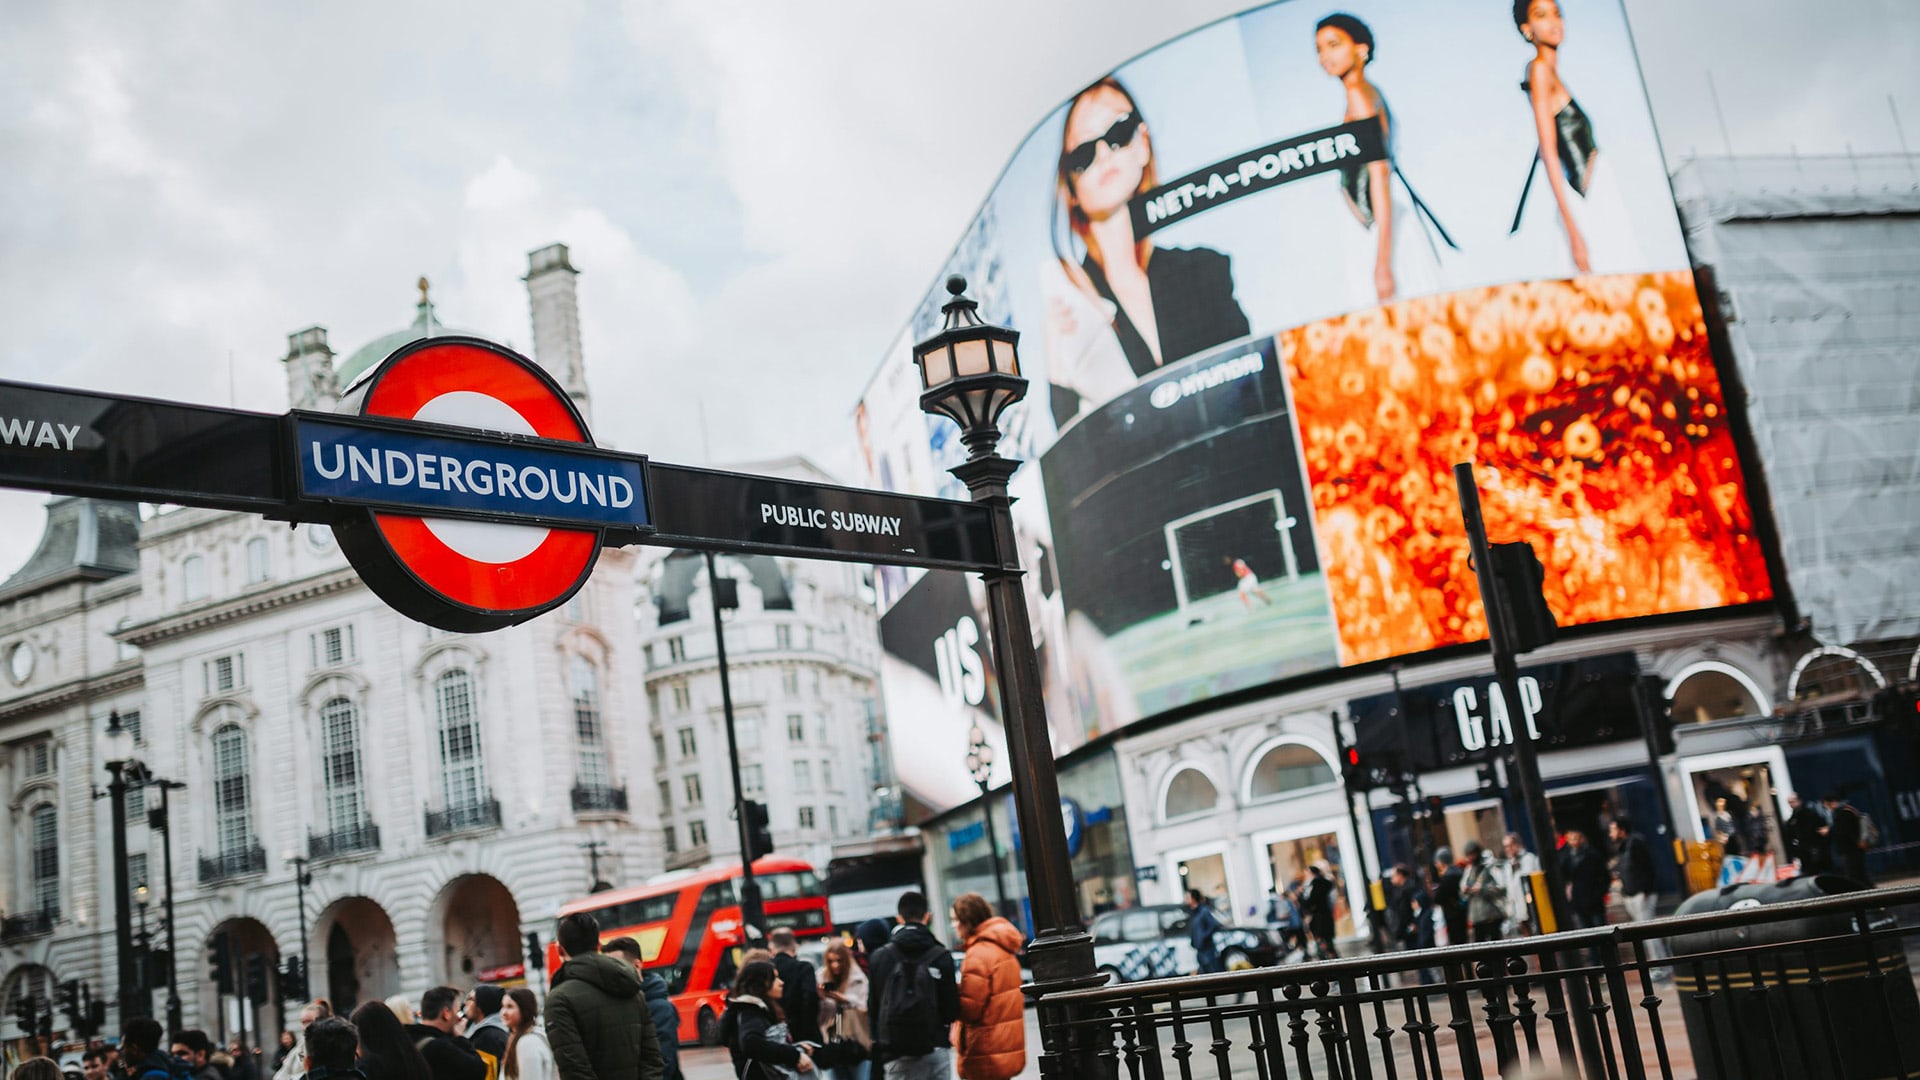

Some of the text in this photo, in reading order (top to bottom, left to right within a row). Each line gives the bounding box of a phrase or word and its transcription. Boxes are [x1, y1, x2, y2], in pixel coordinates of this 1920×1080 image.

[1145, 133, 1361, 224] NET-A-PORTER
[312, 441, 634, 509] UNDERGROUND
[761, 503, 901, 536] PUBLIC SUBWAY
[1453, 676, 1543, 751] GAP
